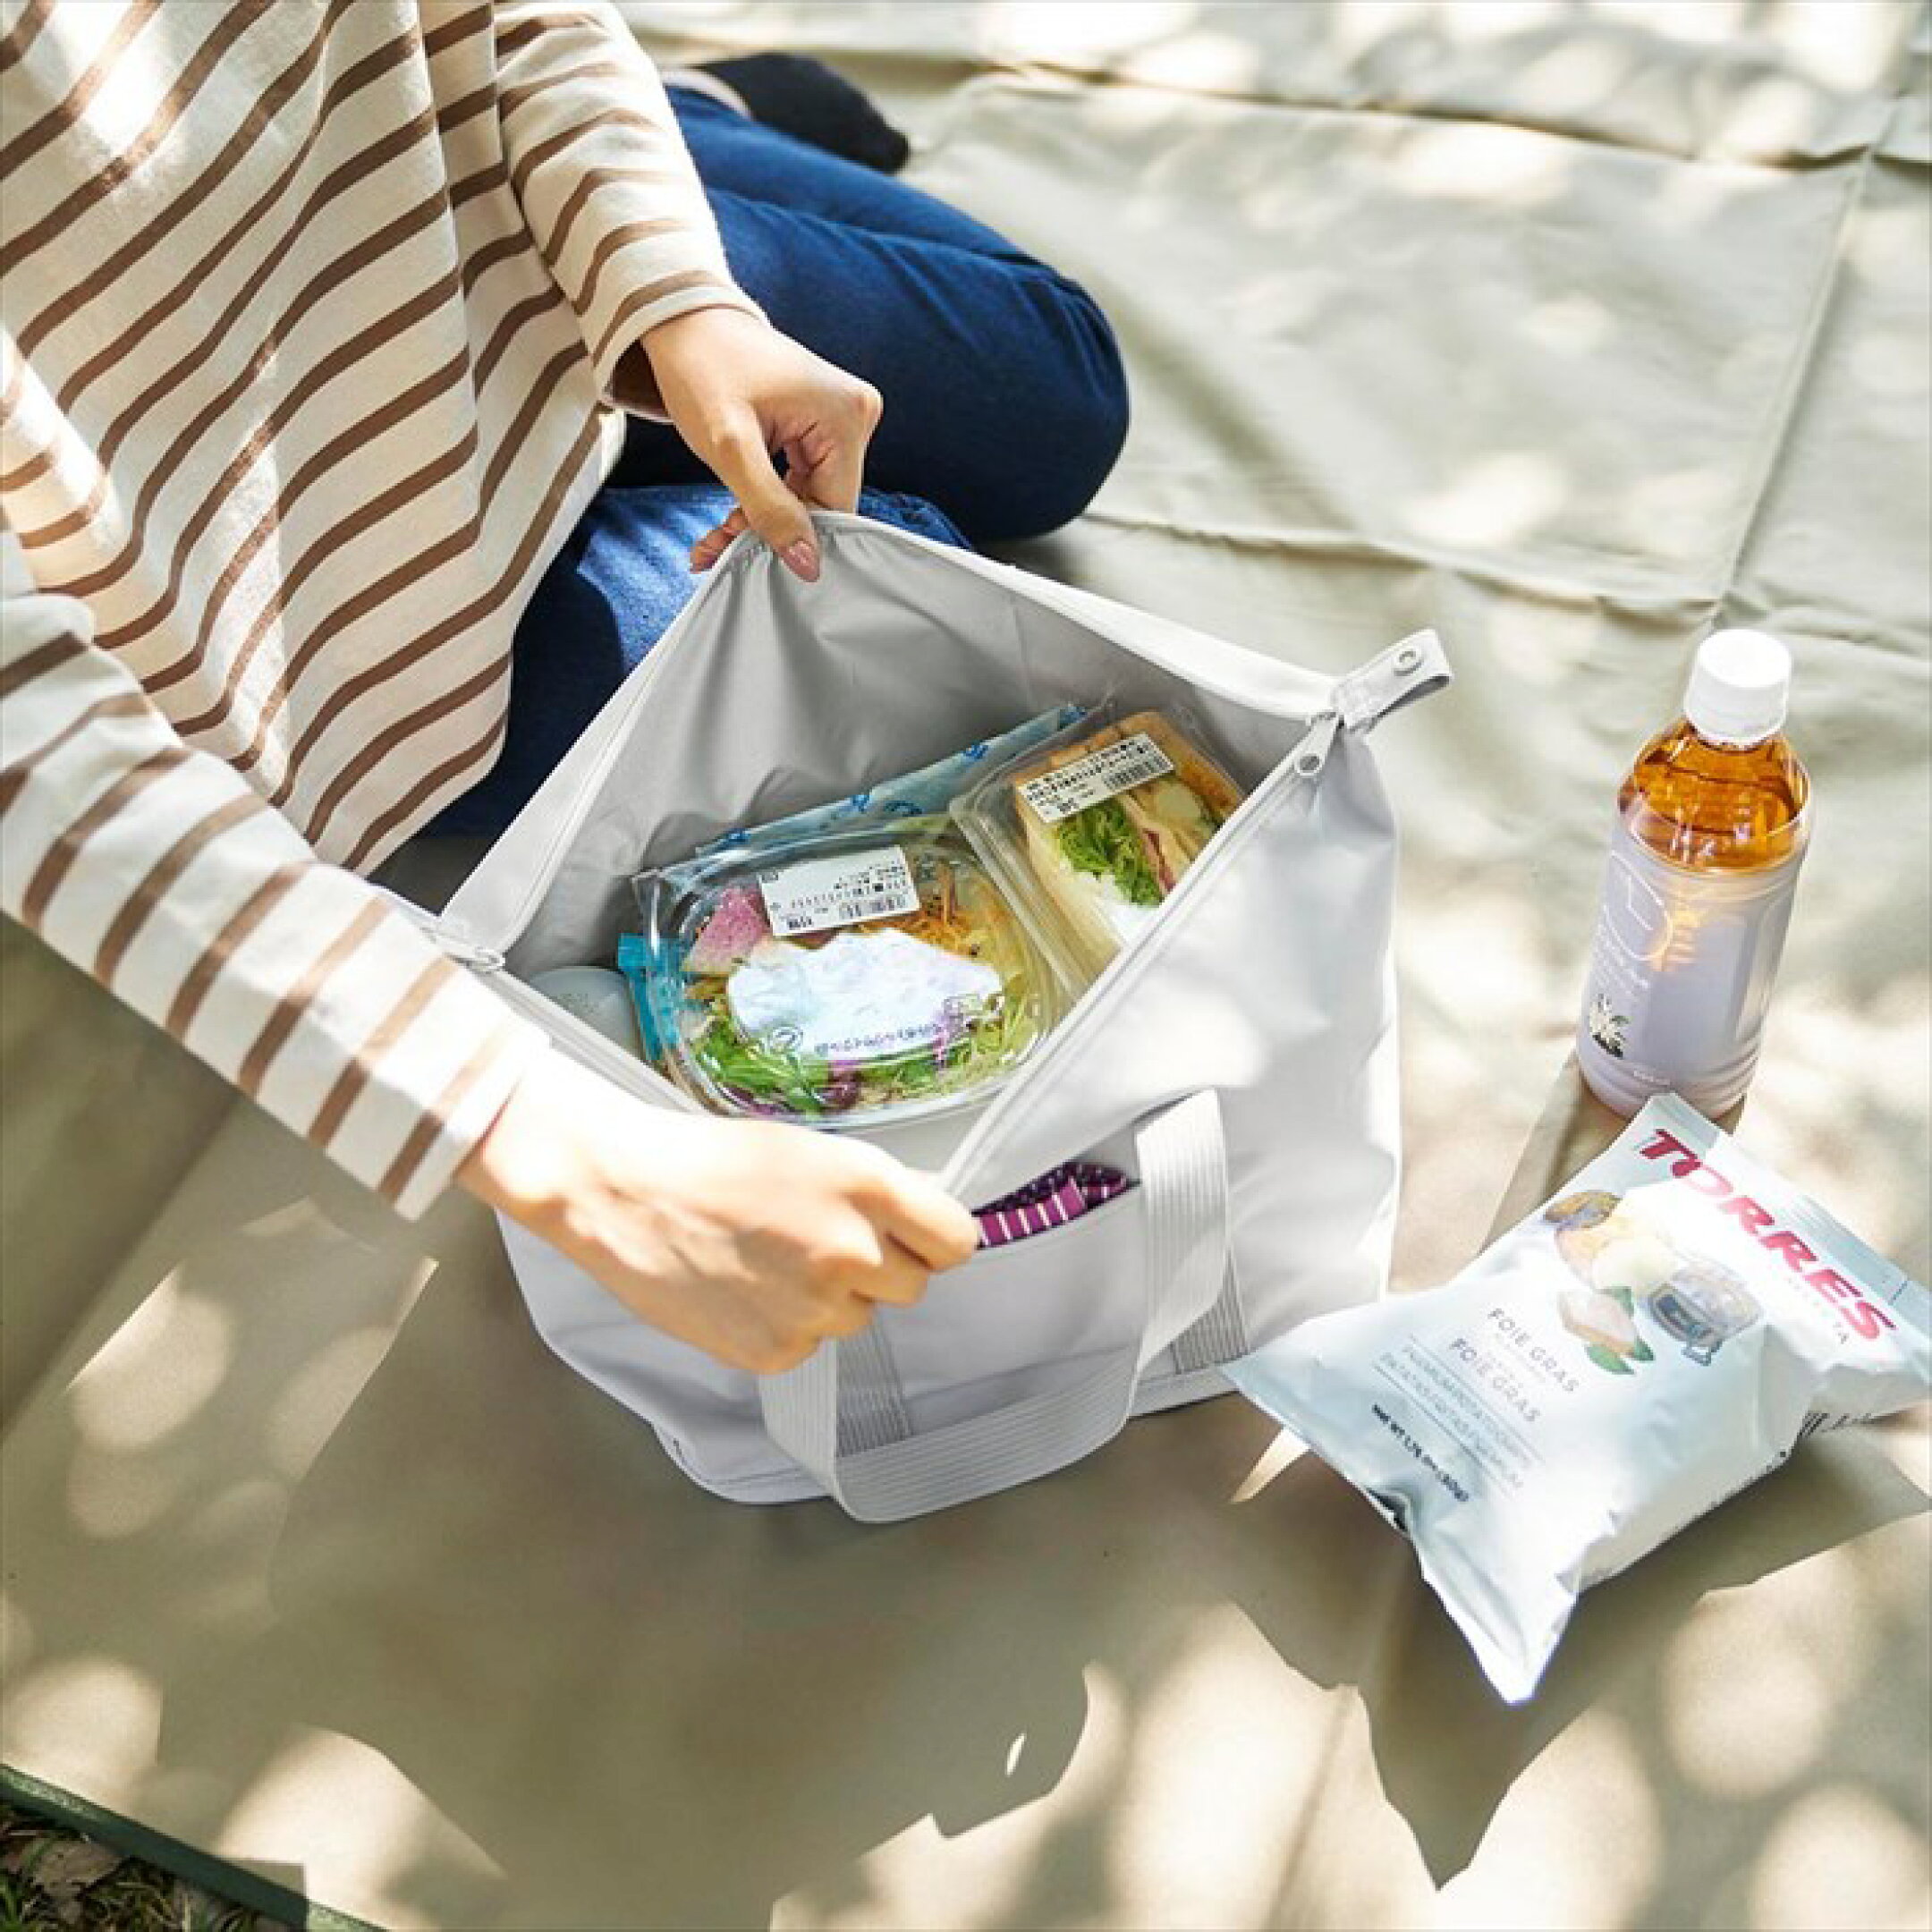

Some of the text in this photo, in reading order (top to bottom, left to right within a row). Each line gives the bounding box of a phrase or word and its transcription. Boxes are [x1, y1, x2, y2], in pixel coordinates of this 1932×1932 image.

[1639, 1128, 1897, 1340] TORRES
[1449, 1338, 1494, 1377] FOIE
[1492, 1376, 1541, 1423] GRAS
[1487, 1307, 1531, 1347] FOIE
[1529, 1346, 1579, 1392] GRAS
